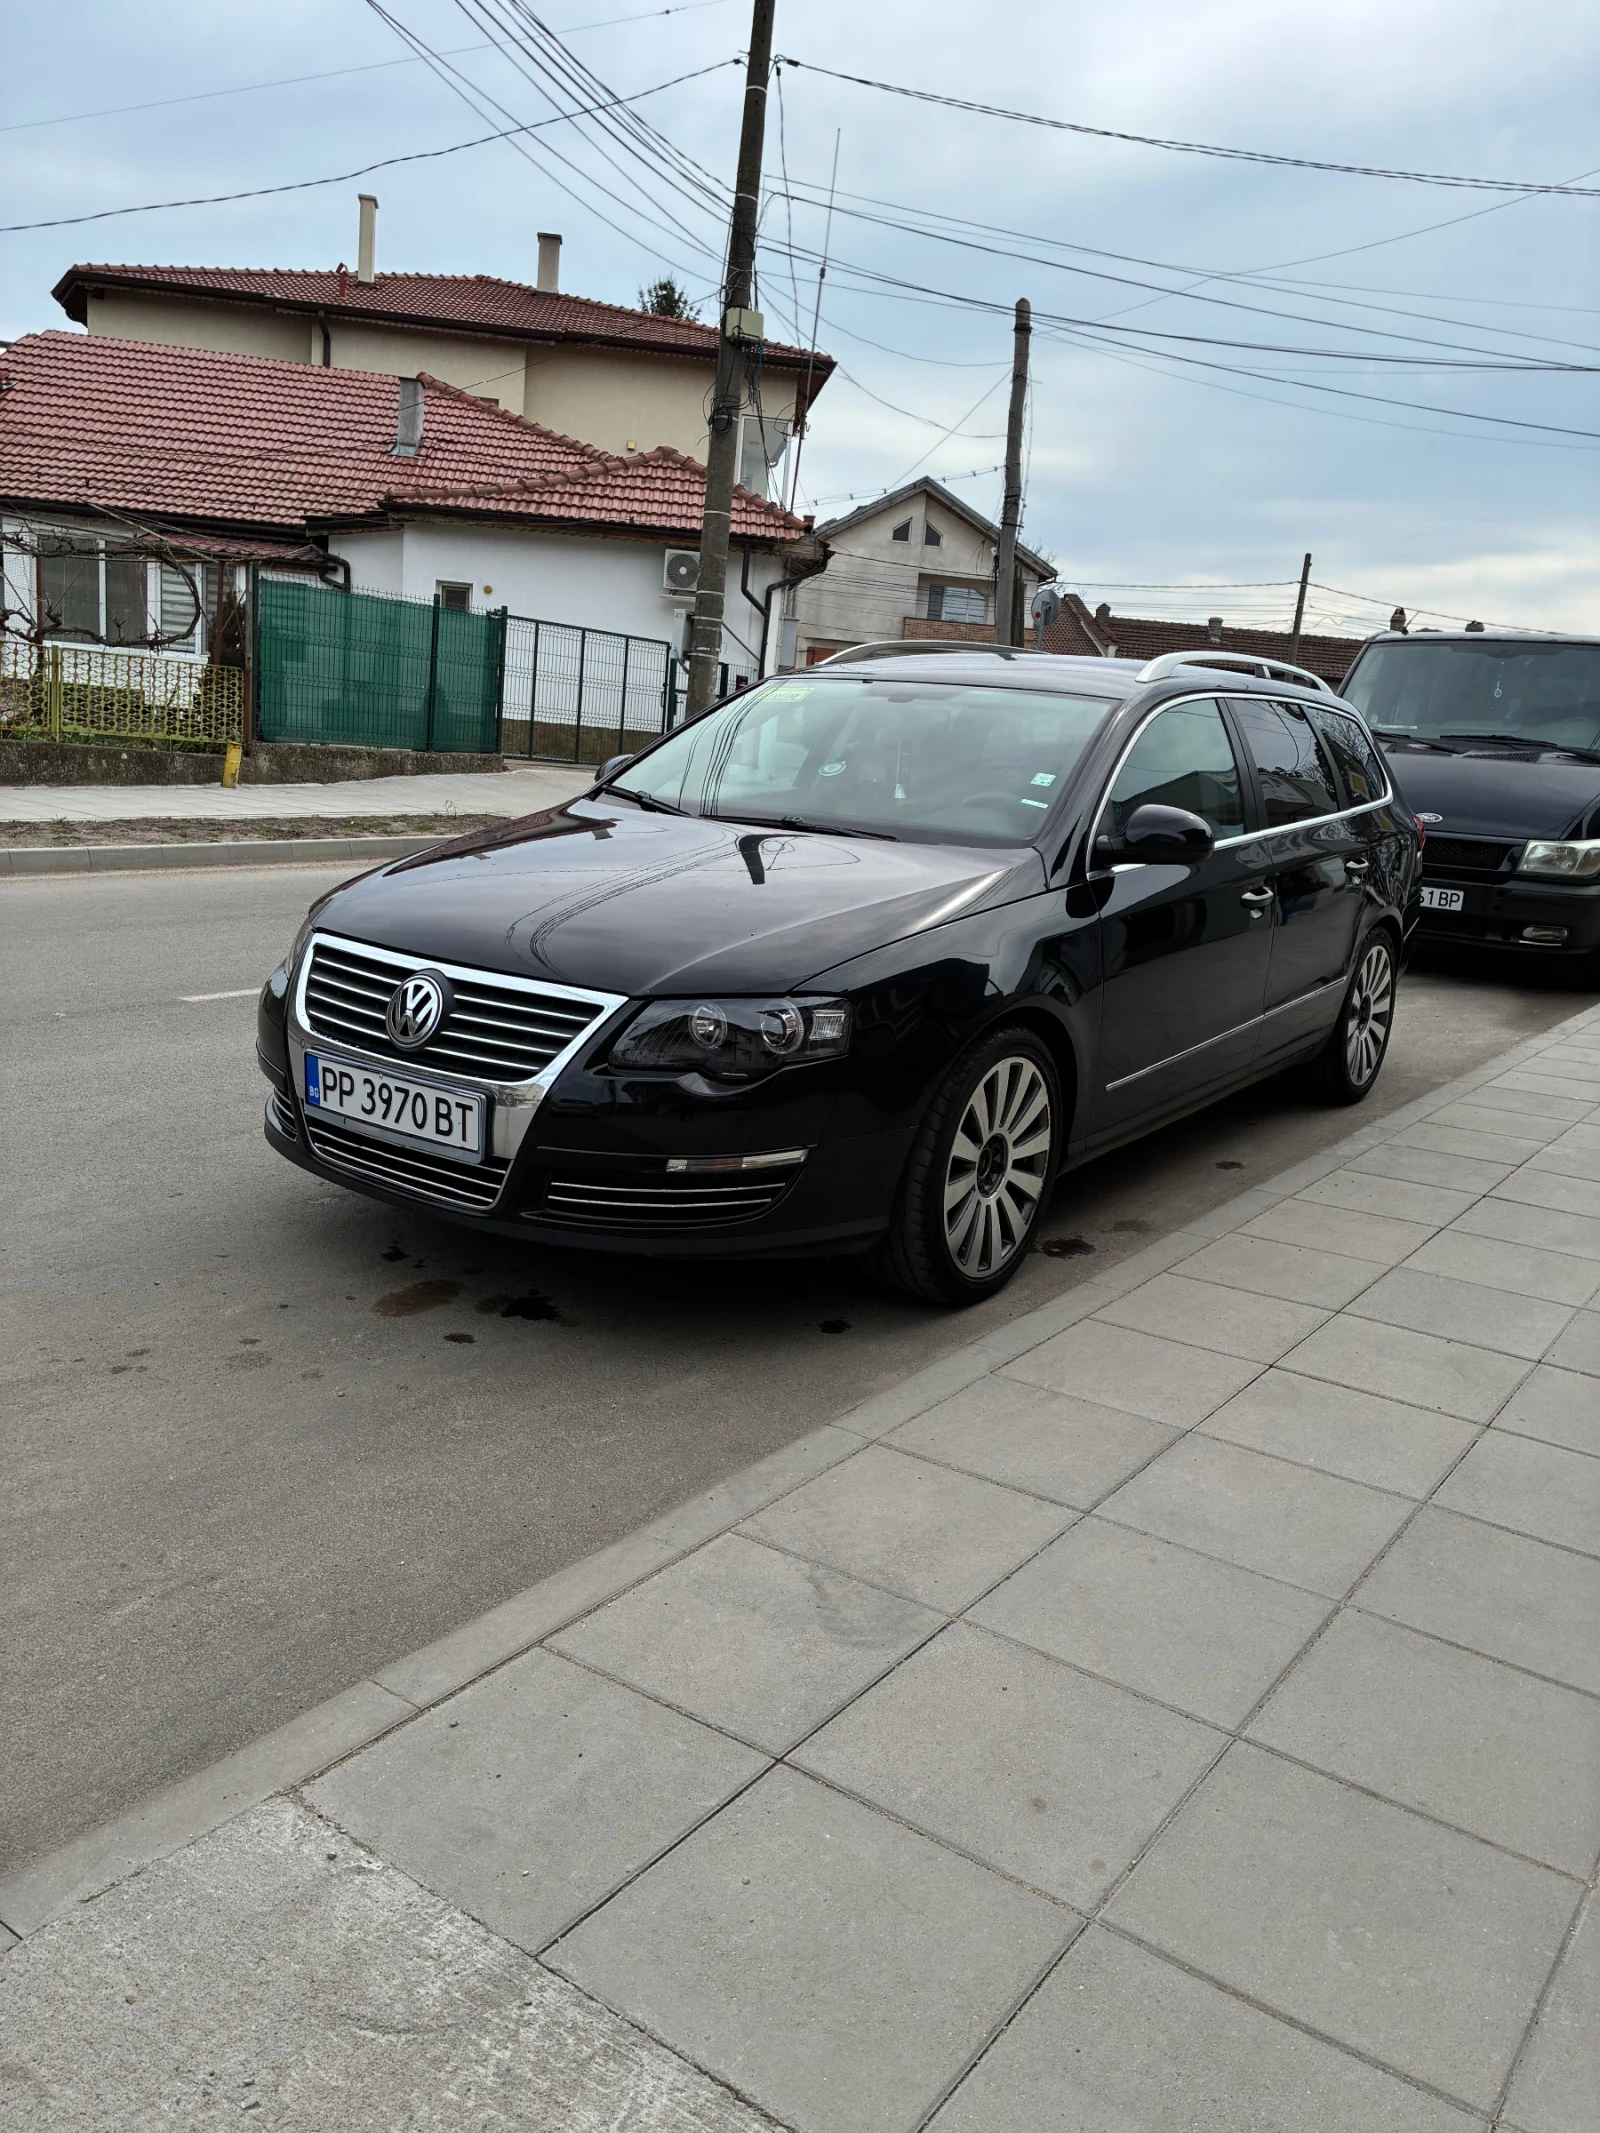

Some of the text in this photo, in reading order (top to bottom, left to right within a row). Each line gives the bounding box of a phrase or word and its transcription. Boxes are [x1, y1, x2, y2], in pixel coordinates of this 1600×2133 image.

[1438, 891, 1460, 908] BP
[389, 977, 443, 1042] VW
[309, 1085, 320, 1099] BG
[322, 1066, 474, 1142] PP 3970 BT
